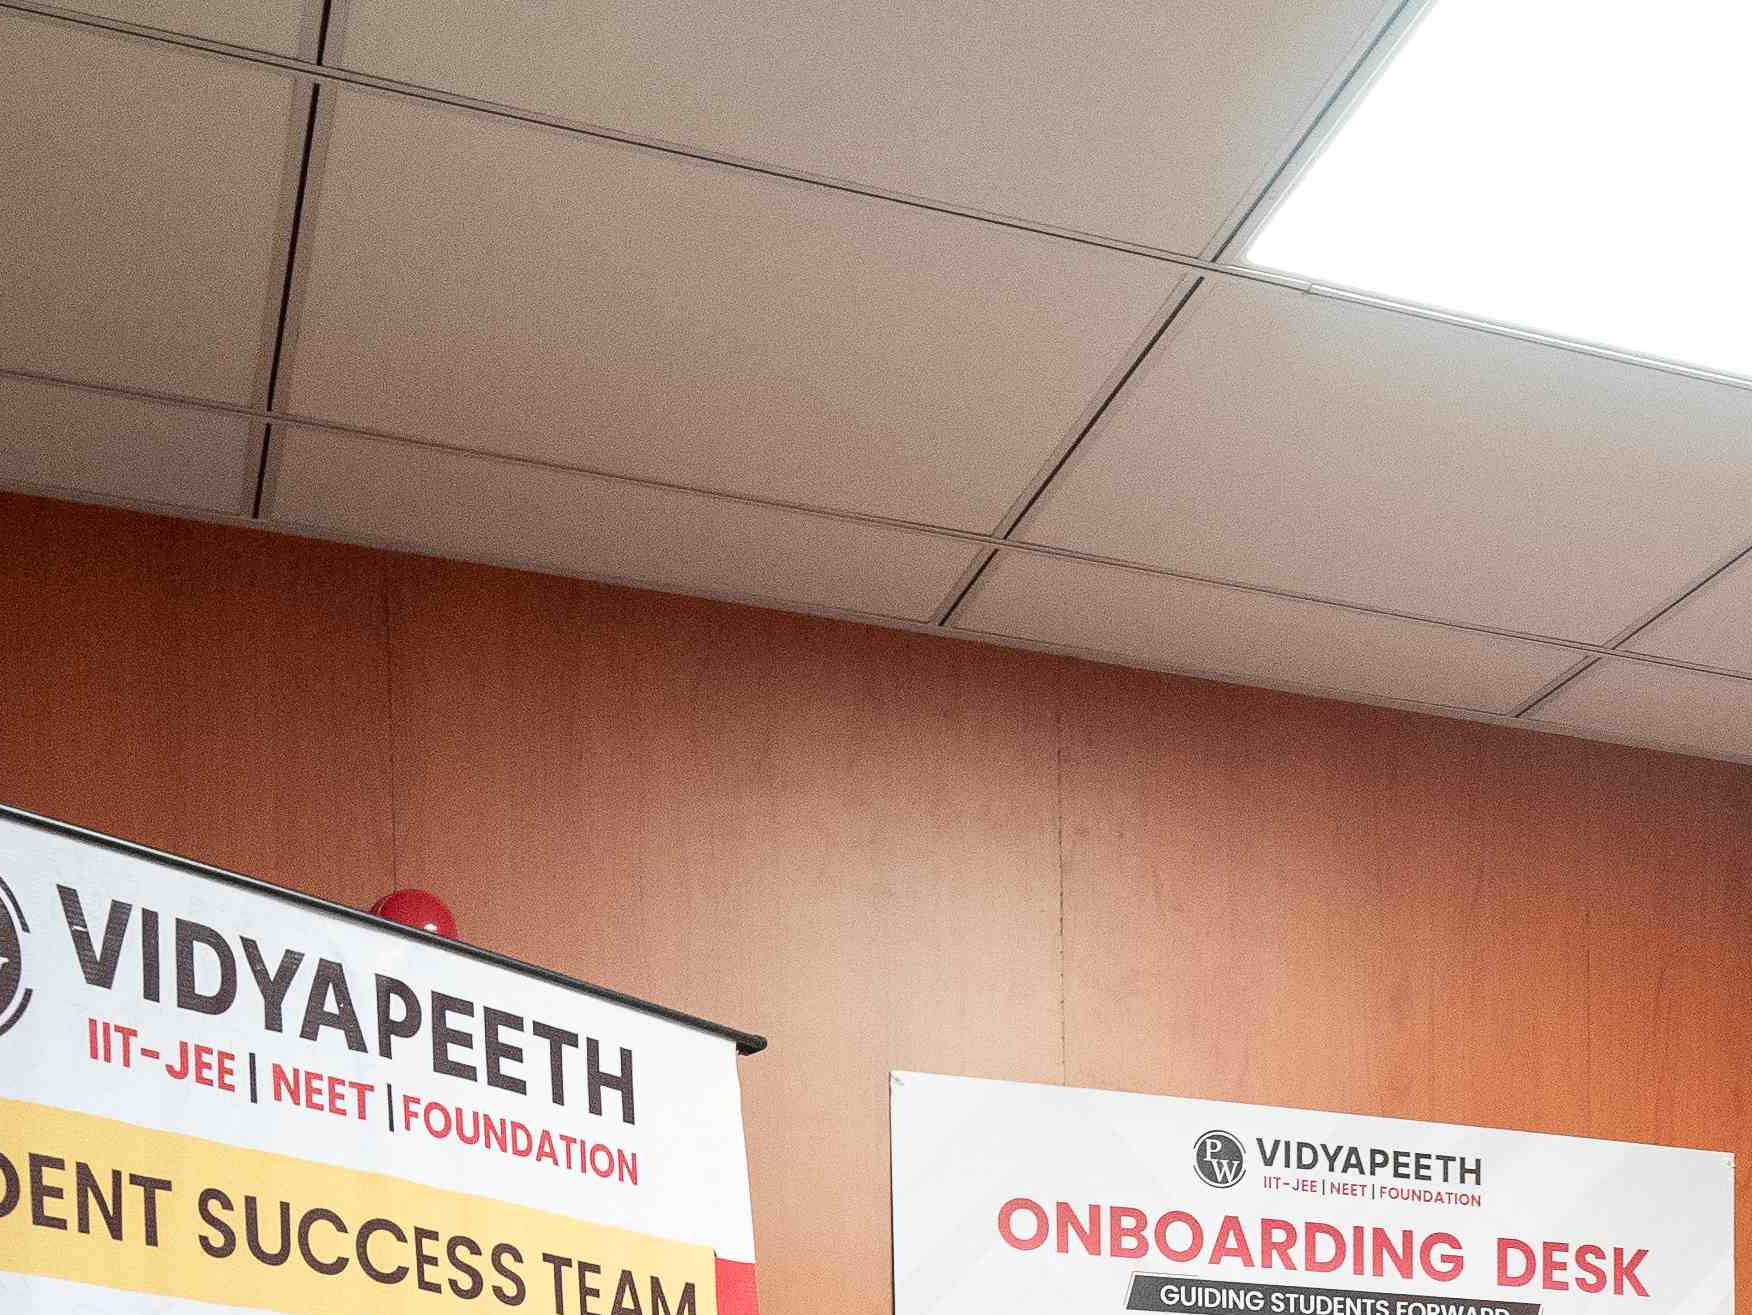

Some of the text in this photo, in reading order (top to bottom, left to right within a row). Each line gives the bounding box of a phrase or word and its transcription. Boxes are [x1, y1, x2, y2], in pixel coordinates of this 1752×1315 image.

[56, 885, 636, 1124] VIDYAPEETH
[89, 1017, 639, 1186] IIT-JEE NEET FOUNDATION
[1256, 1137, 1482, 1187] VIDYAPEETH
[1263, 1177, 1482, 1207] IIT-JEE NEET FOUNDATION
[198, 1187, 527, 1307] SUCCESS
[996, 1197, 1651, 1298] ONBOARDING DESK
[1160, 1284, 1266, 1313] GUIDING
